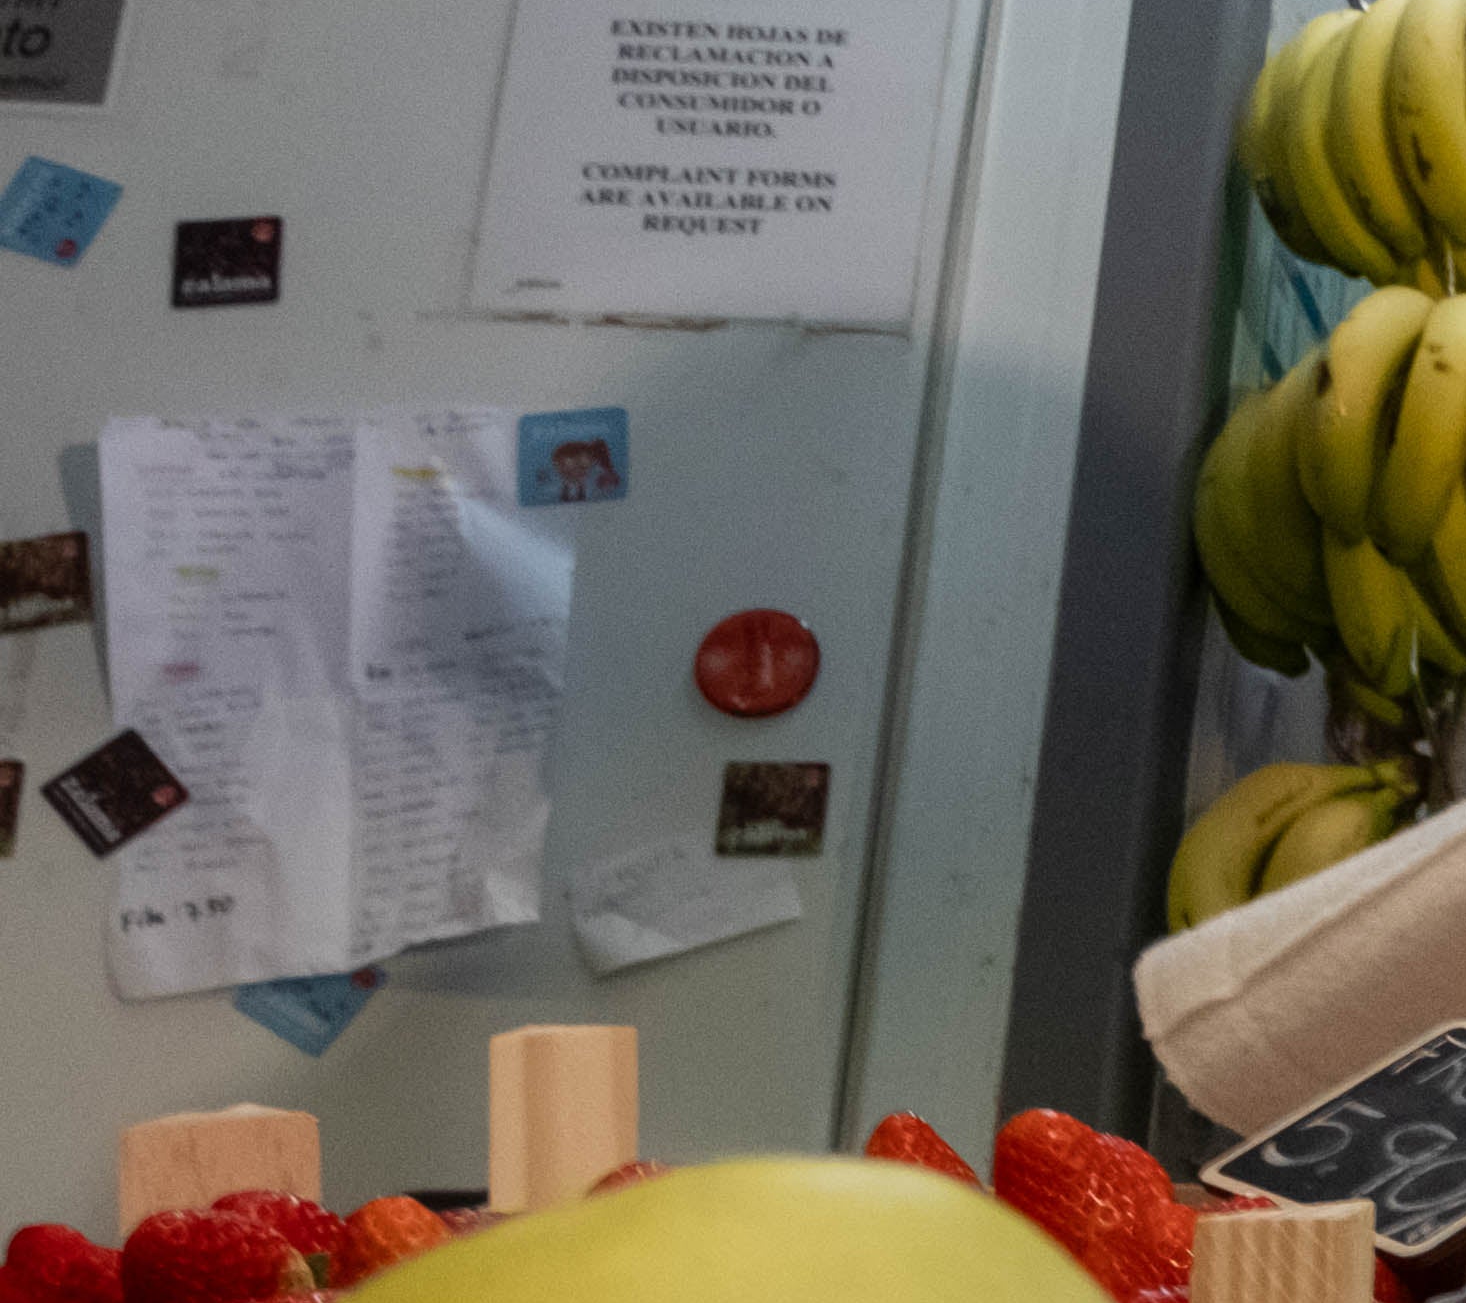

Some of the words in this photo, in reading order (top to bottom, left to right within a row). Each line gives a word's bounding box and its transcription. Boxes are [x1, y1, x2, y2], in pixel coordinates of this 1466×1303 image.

[609, 19, 719, 40] EXISTEN
[726, 25, 810, 45] HOJAS
[815, 28, 849, 46] DE
[616, 42, 811, 67] RECLAMACION
[819, 51, 836, 69] A
[611, 67, 777, 90] DISPOSICION
[783, 73, 832, 94] DEL
[616, 92, 795, 116] CONSUMIDOR
[801, 99, 822, 116] O
[581, 162, 741, 187] COMPLAINT
[746, 168, 837, 188] FORMS
[578, 187, 630, 206] ARE
[642, 189, 788, 212] AVAILABLE
[794, 193, 834, 213] ON
[641, 213, 763, 237] REQUEST
